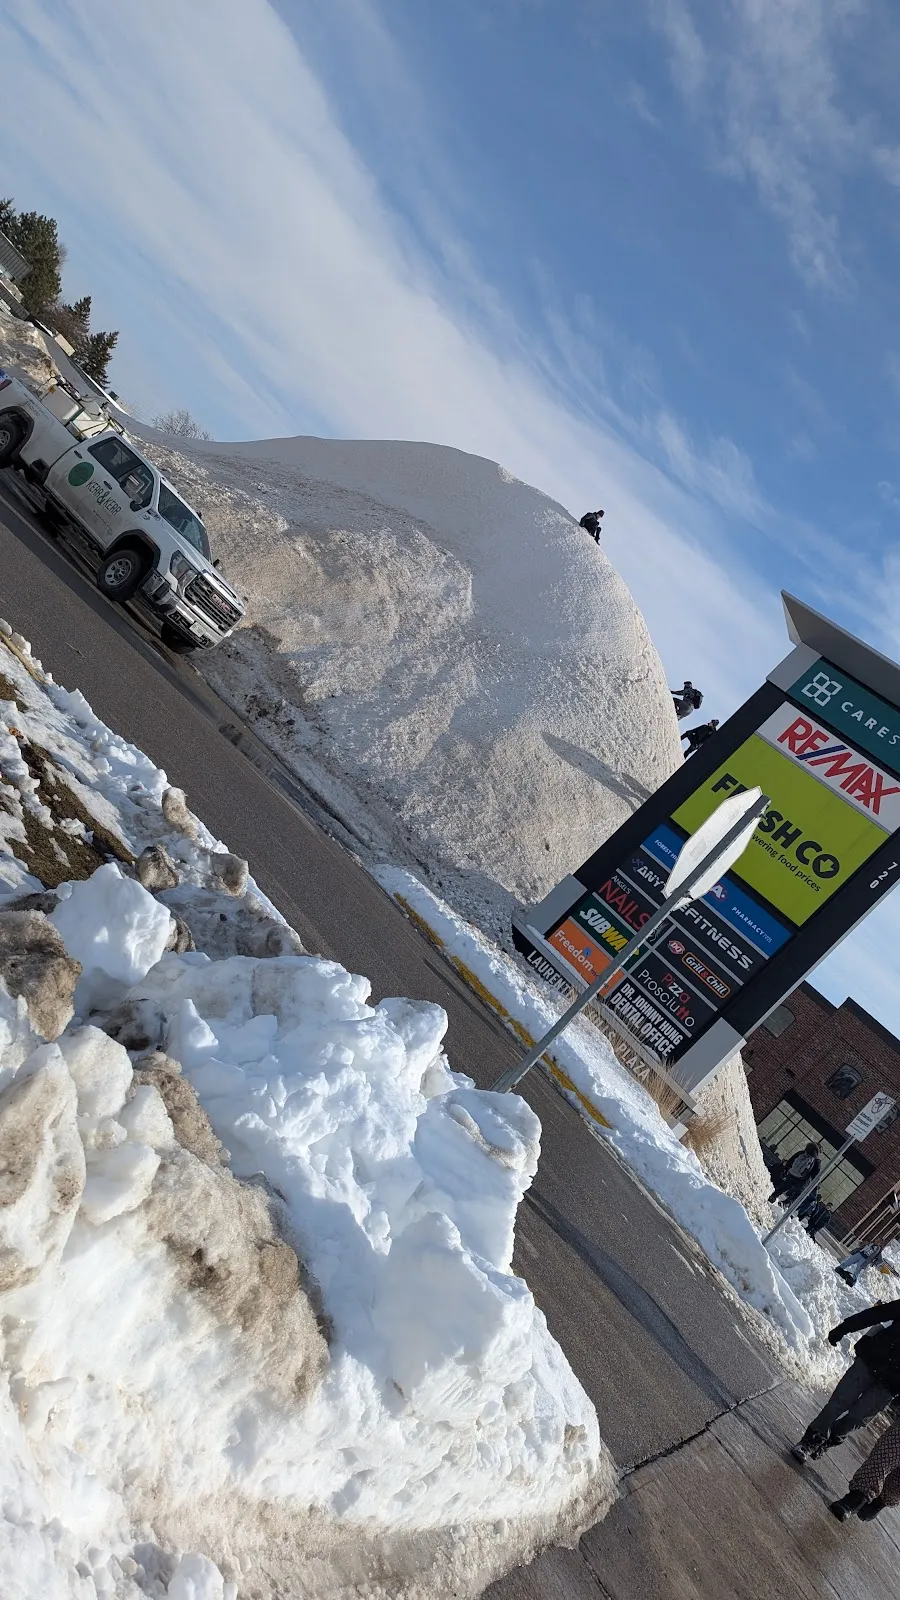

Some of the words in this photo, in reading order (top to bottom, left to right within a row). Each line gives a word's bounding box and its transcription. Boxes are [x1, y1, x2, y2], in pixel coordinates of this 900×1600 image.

[777, 716, 900, 816] RE/MAX
[654, 839, 672, 857] FOREST
[731, 906, 765, 937] PHARMACY
[752, 833, 778, 858] wering
[777, 851, 799, 872] food
[796, 869, 822, 893] prices
[579, 907, 640, 957] SUBWA
[598, 879, 652, 931] NAILS
[554, 930, 594, 974] Freedom
[620, 982, 635, 1000] DR.
[633, 993, 662, 1026] JOHNNY
[660, 1019, 683, 1046] HUNG
[637, 969, 695, 1027] Prosciutto
[661, 973, 691, 1003] Pizza
[611, 993, 644, 1028] DENTAL
[641, 1021, 675, 1057] OFFICE
[616, 1044, 651, 1081] PLAZA
